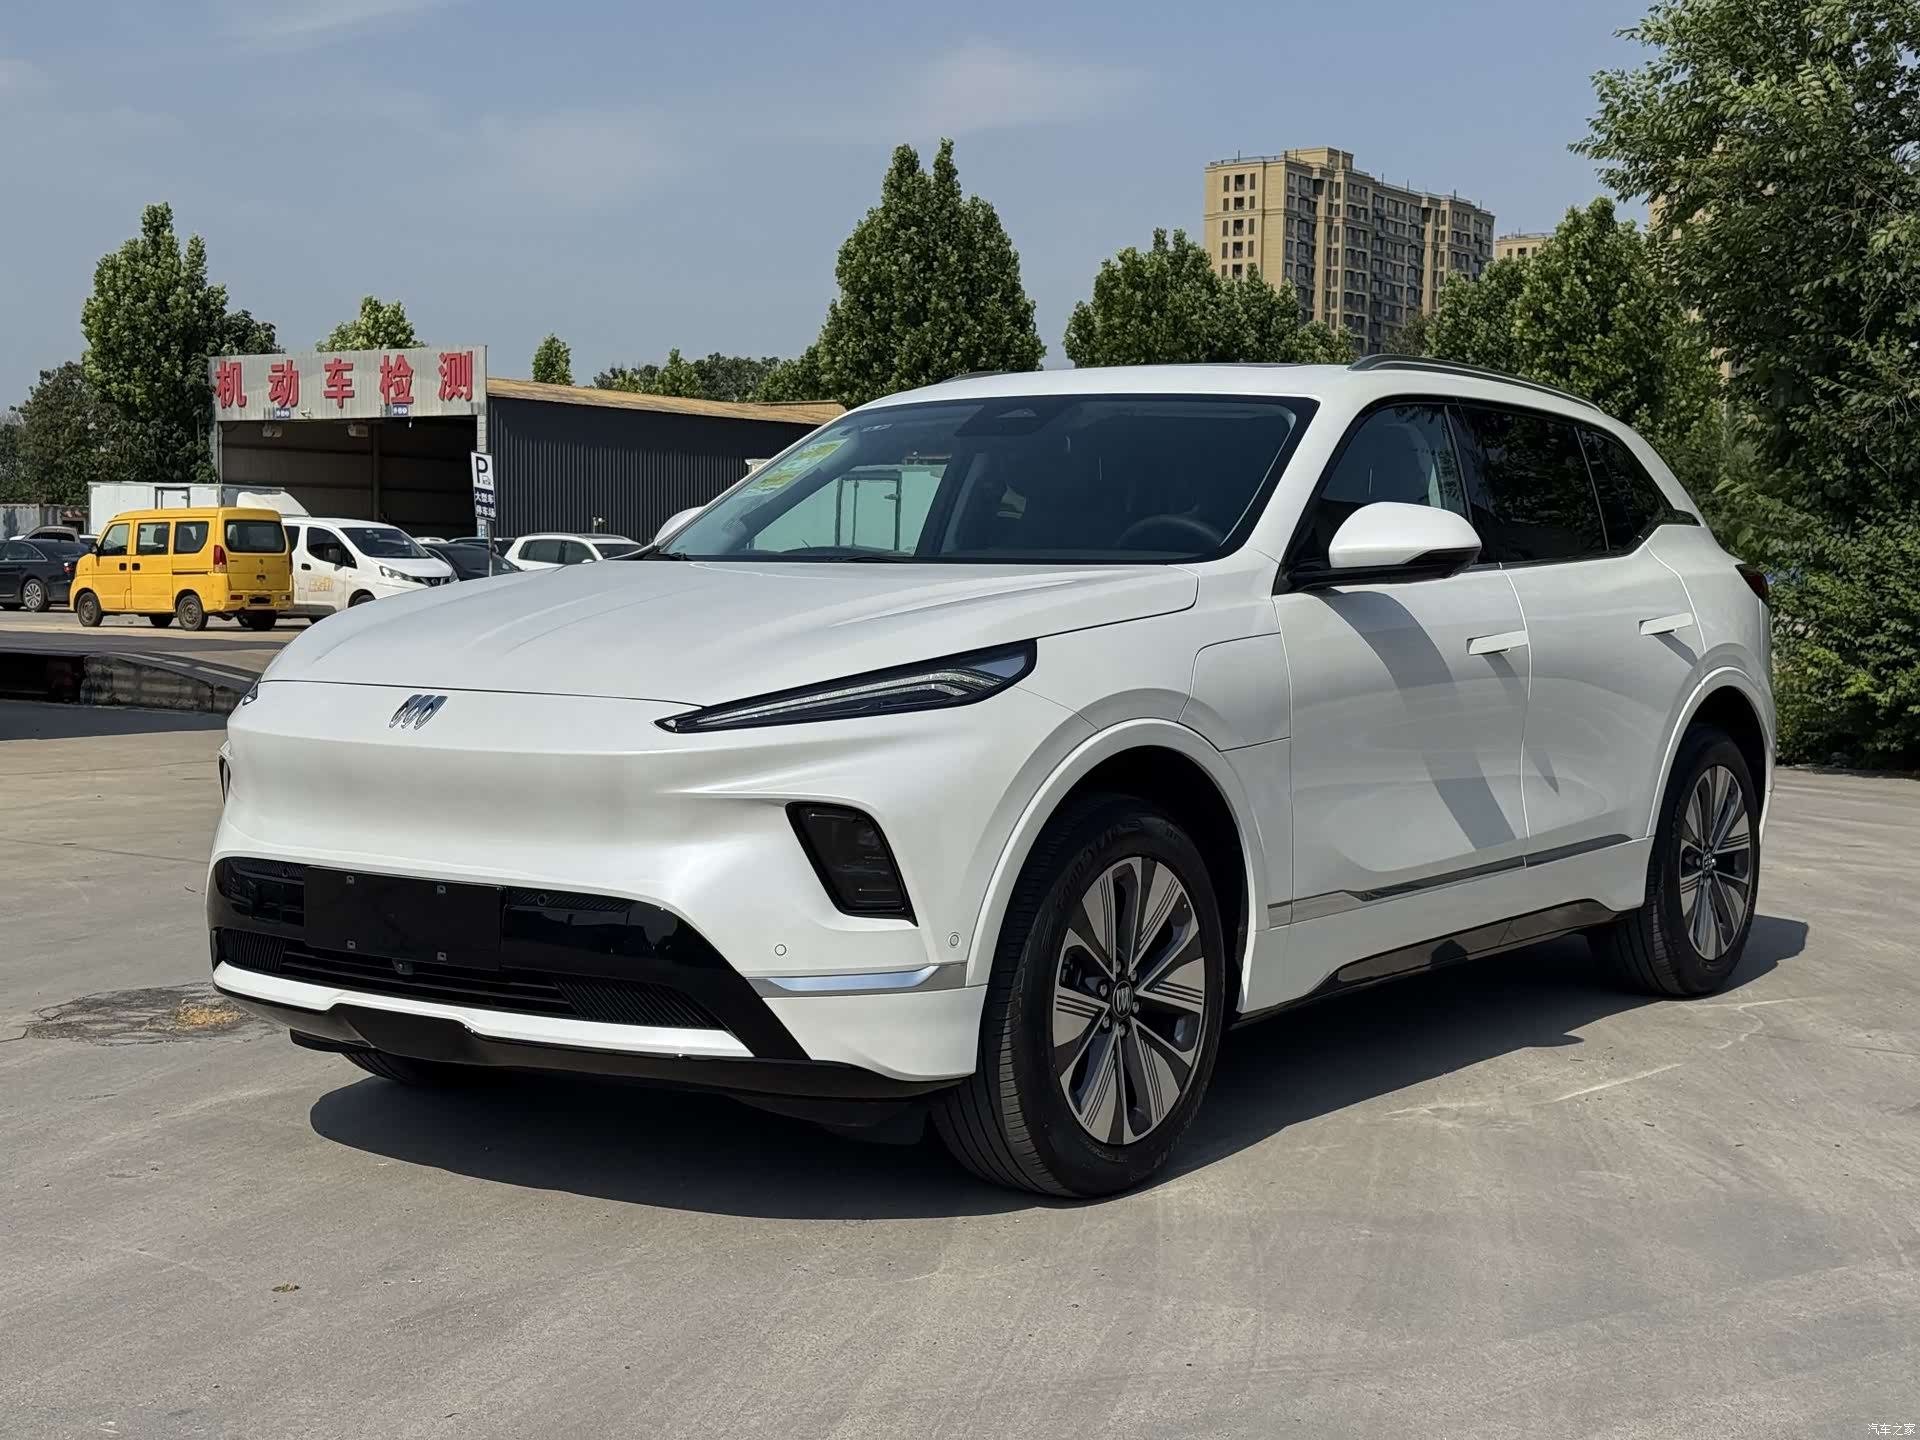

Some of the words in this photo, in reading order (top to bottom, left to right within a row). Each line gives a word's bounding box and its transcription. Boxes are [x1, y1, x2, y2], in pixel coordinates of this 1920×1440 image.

[214, 351, 473, 408] 机动车检测
[476, 456, 488, 483] P
[475, 491, 494, 504] 大型车
[476, 505, 496, 517] 停车场
